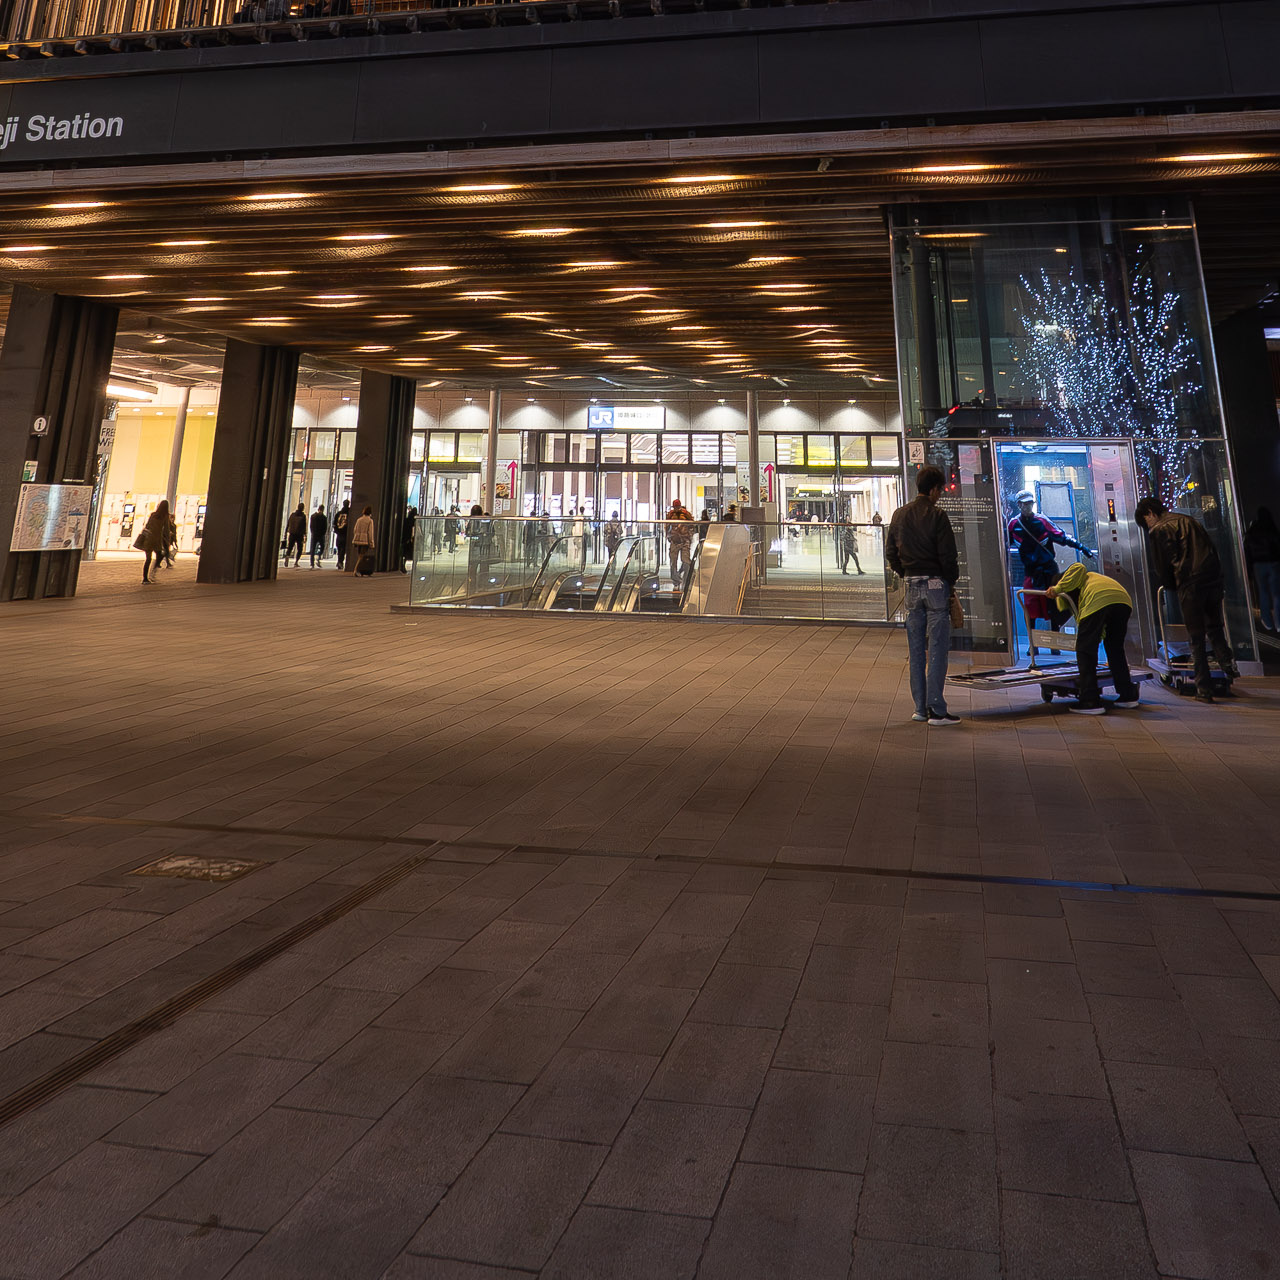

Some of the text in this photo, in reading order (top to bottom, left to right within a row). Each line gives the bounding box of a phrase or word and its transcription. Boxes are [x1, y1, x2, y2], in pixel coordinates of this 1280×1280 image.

[25, 111, 124, 143] Station
[591, 411, 612, 425] JR
[101, 427, 116, 437] FRE
